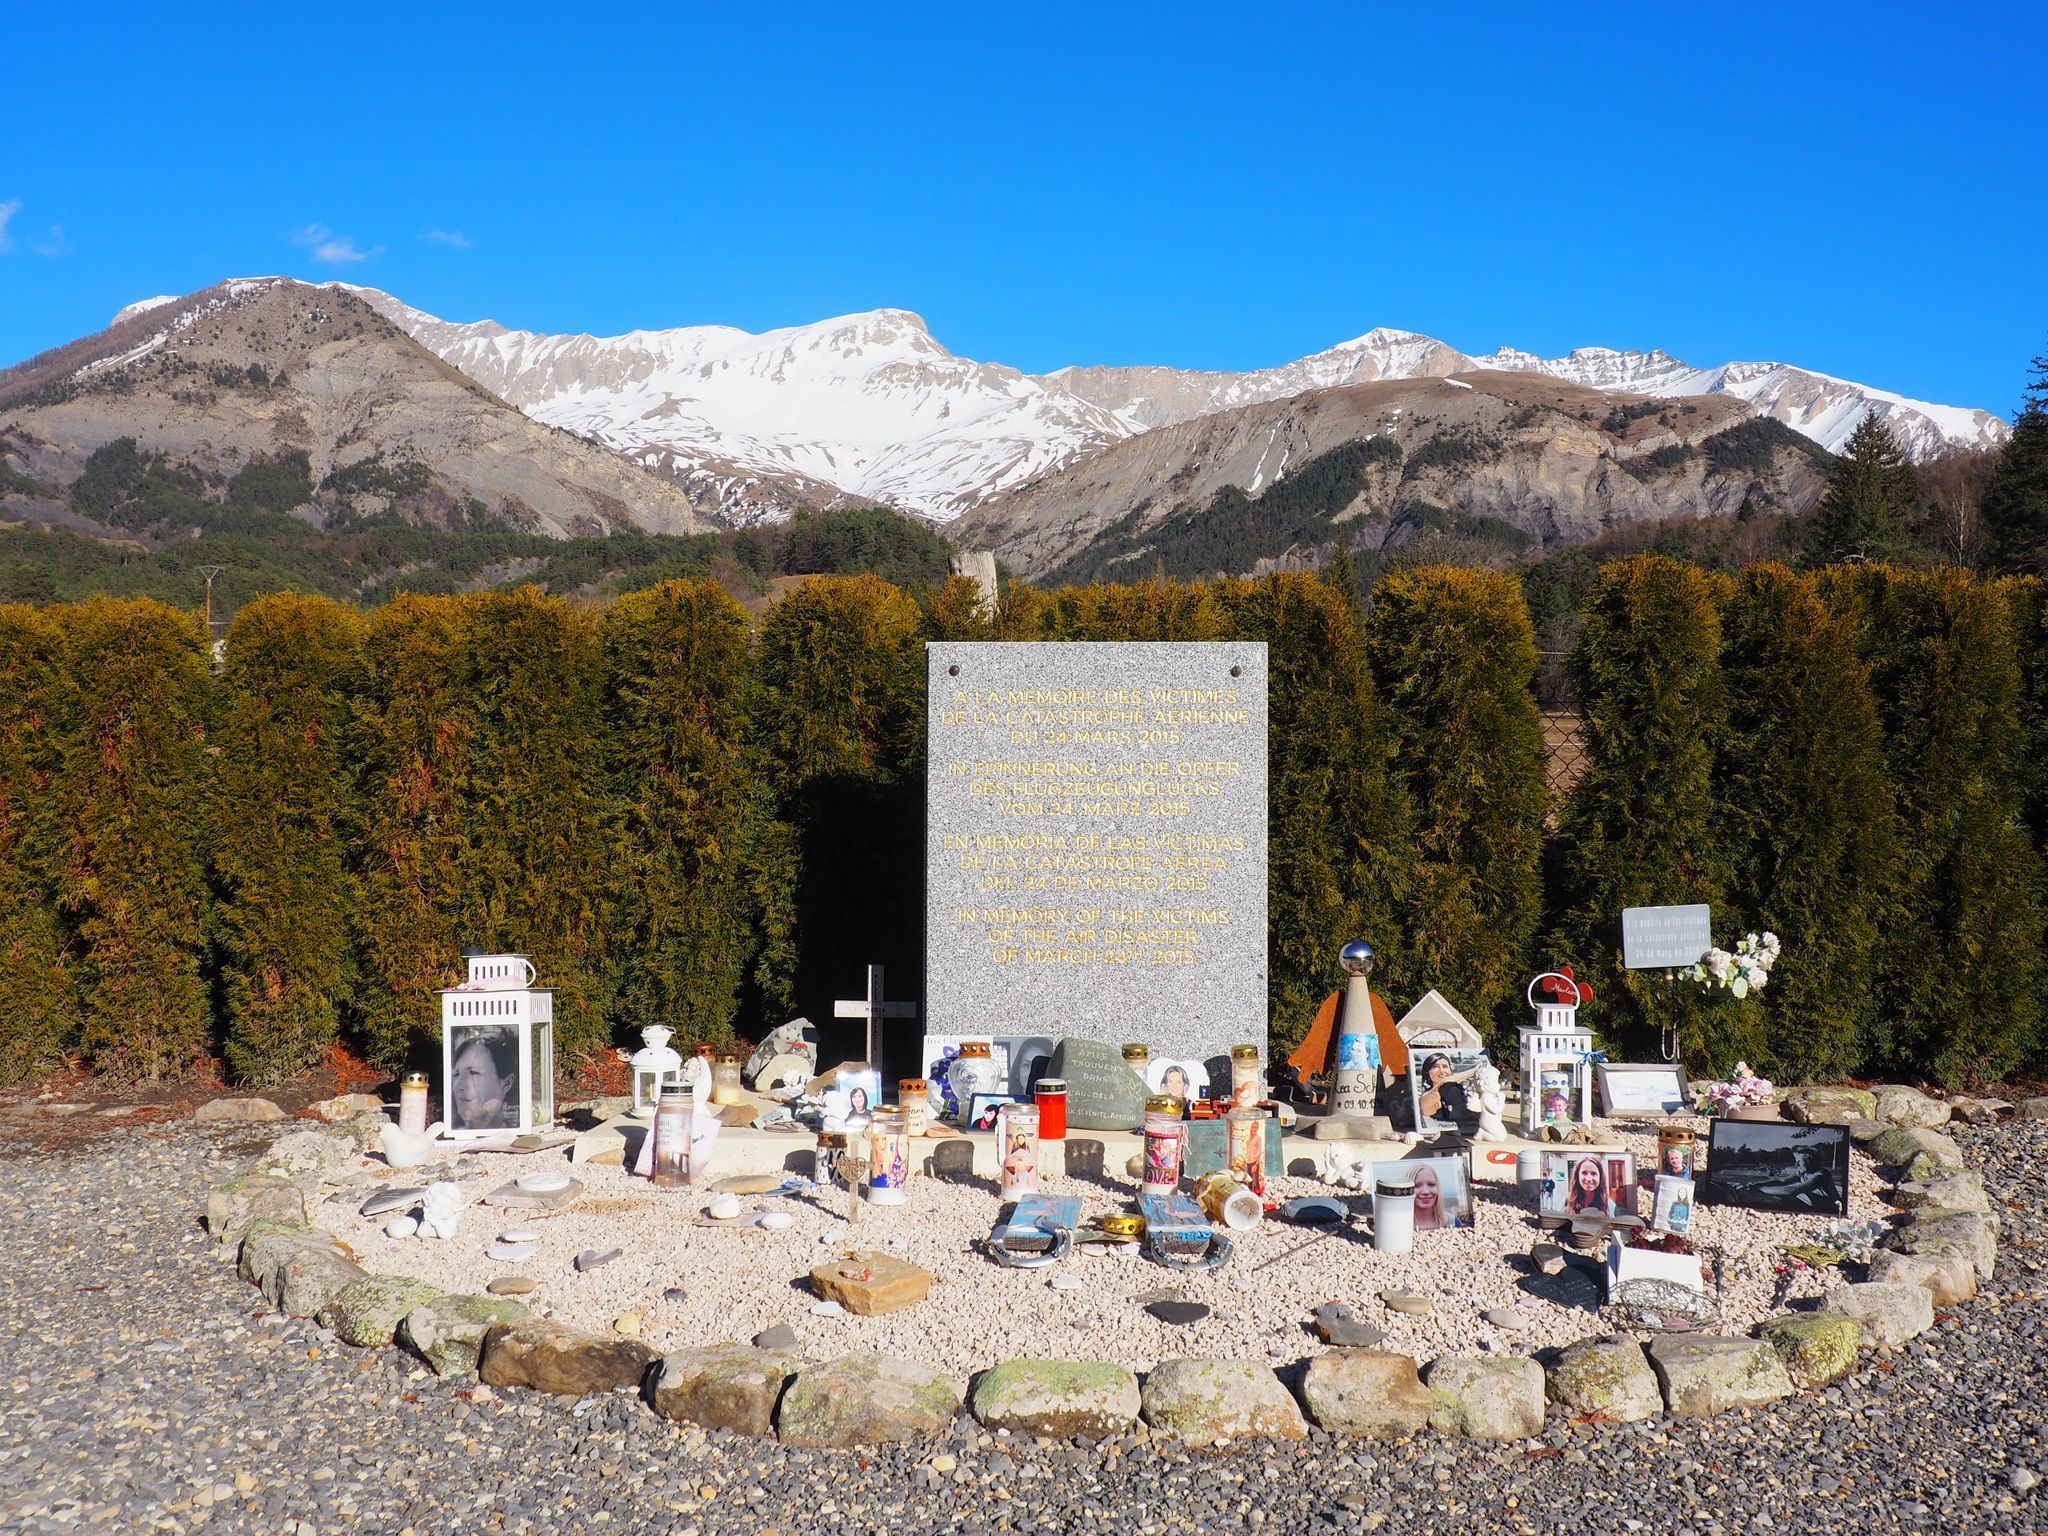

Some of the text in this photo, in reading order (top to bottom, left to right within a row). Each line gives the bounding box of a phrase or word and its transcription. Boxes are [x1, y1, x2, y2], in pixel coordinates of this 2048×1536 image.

[955, 690, 968, 704] A
[975, 690, 1002, 704] LA
[1104, 689, 1142, 704] DES
[1149, 689, 1238, 704] VICTIMES
[942, 710, 967, 724] DE
[974, 711, 998, 724] LA
[1005, 709, 1146, 724] CATASTROPHE
[1011, 730, 1181, 744] DU 24 MARS 2015
[948, 762, 967, 776] IN
[974, 761, 1098, 776] ERINNERUNG
[1105, 762, 1133, 776] AN
[1141, 761, 1171, 776] DIE
[970, 782, 1006, 796] DES
[999, 802, 1043, 816] VOM
[1149, 802, 1191, 816] 2015
[944, 836, 969, 850] EN
[976, 836, 1069, 850] MEMORIA
[1076, 836, 1101, 850] DE
[1108, 836, 1146, 851] LAS
[960, 855, 986, 870] DE
[993, 856, 1018, 869] LA
[980, 875, 1209, 891] DEL 24 DE MARZO 2015
[958, 908, 1231, 925] IN MEMORY OF THE VICTIMS
[988, 929, 1199, 944] OF THE AIR DISASTER
[992, 948, 1018, 963] OF
[1025, 948, 1098, 963] MARCH
[1153, 949, 1196, 964] 2015
[1083, 1073, 1108, 1083] DANS
